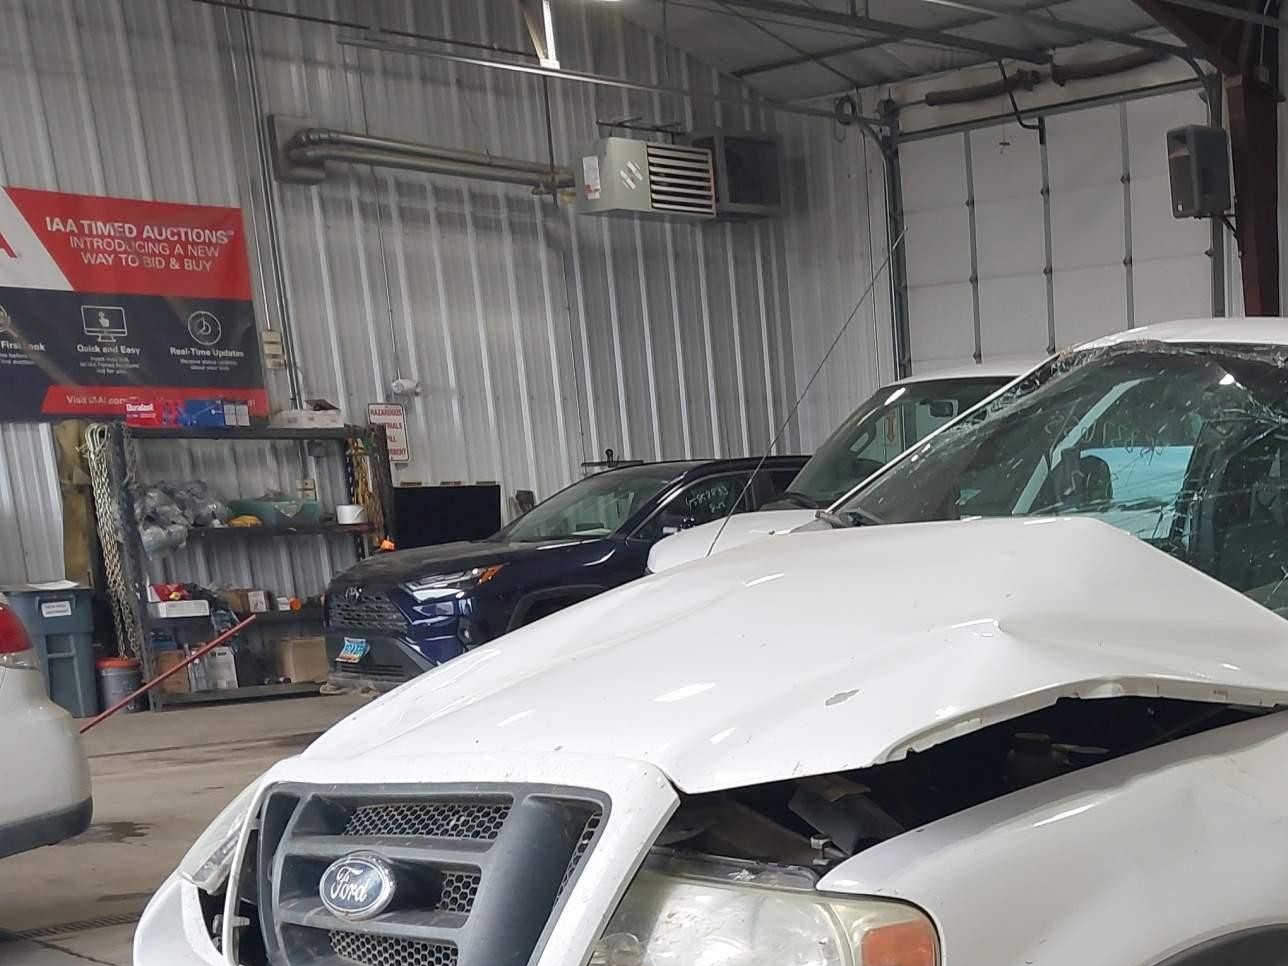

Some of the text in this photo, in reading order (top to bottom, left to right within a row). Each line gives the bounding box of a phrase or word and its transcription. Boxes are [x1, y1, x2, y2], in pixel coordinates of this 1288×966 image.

[46, 216, 78, 234] IAA
[80, 219, 137, 238] TIMED
[70, 236, 220, 258] INTRODUCING A NEW
[81, 251, 213, 272] WAY TO BID & BUY
[66, 395, 87, 405] Visit
[330, 865, 370, 902] Ford
